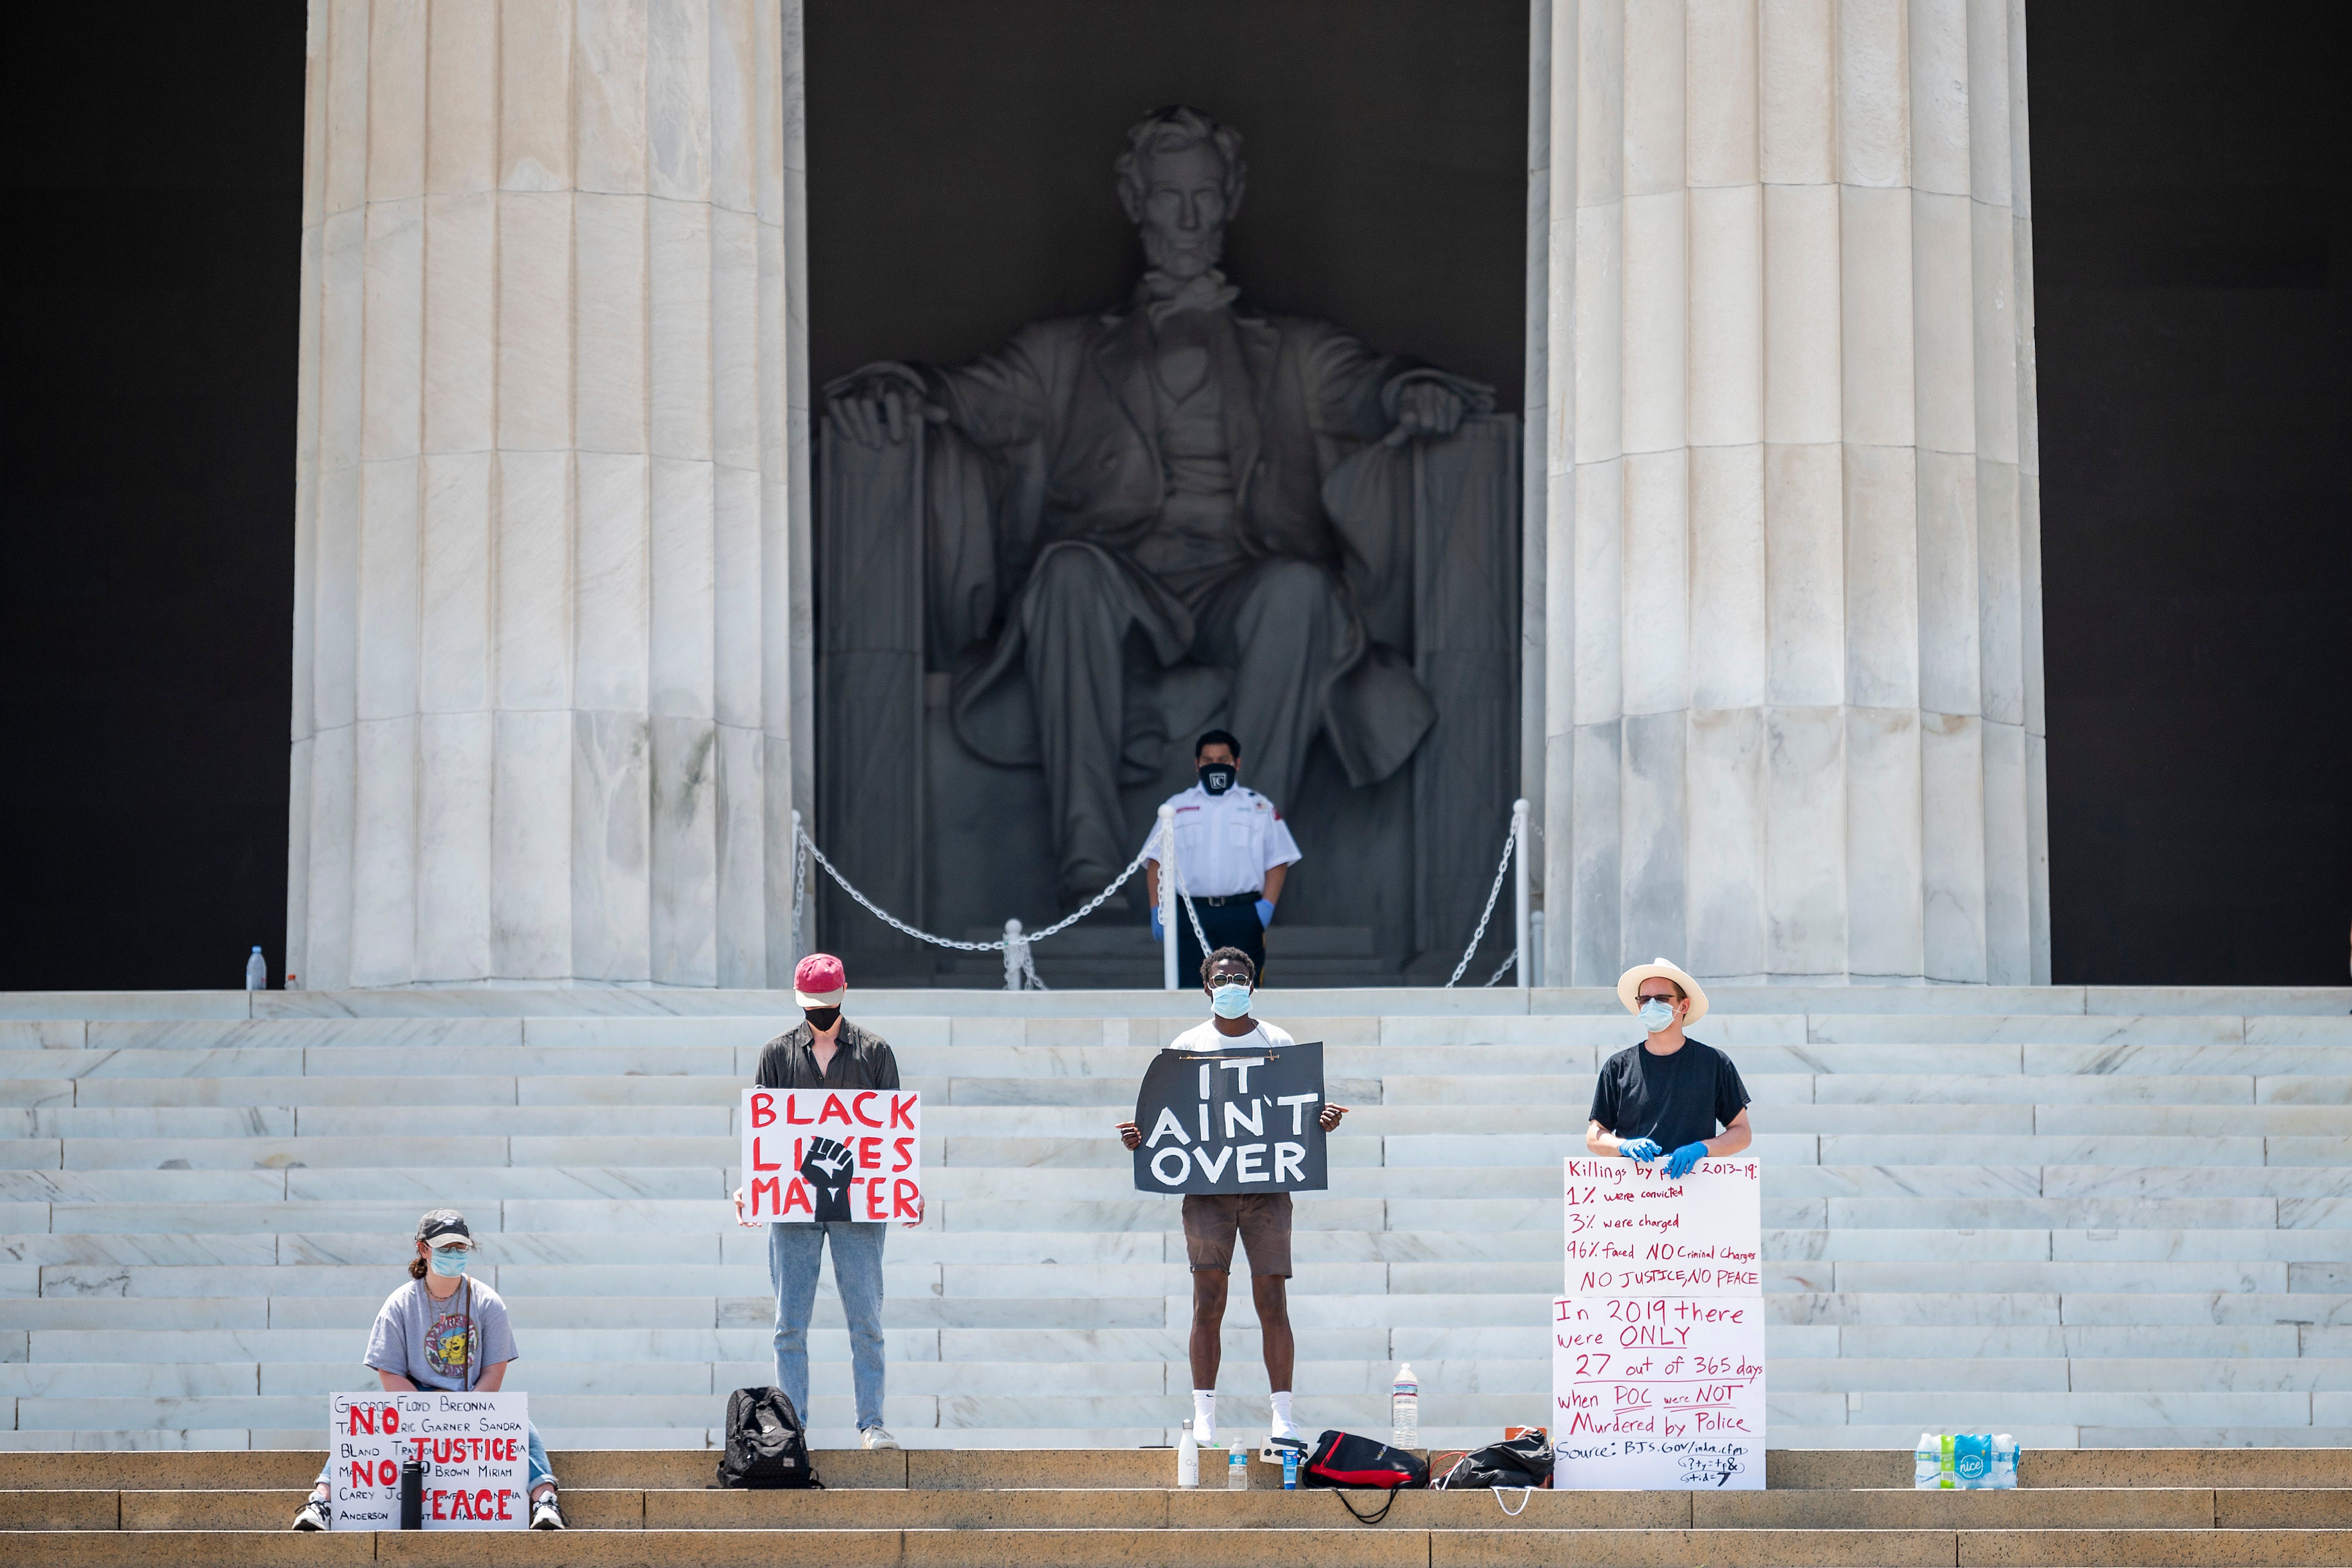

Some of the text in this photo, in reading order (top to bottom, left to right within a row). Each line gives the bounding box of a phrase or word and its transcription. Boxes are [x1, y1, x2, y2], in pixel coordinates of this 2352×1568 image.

[1199, 1058, 1264, 1100] IT
[751, 1092, 917, 1131] BLACK
[1146, 1093, 1318, 1149] AIN'T
[753, 1136, 915, 1173] LIES
[1150, 1142, 1306, 1186] OVER
[1569, 1161, 1627, 1185] Killings
[1635, 1161, 1652, 1180] by
[751, 1176, 919, 1220] MAER
[1567, 1185, 1683, 1206] 1% were convicted
[1569, 1213, 1679, 1234] 3% were charged
[1567, 1240, 1756, 1264] 96% faced NO Criminal Charges
[1580, 1271, 1612, 1291] NO
[1717, 1269, 1760, 1288] PEACE
[1554, 1300, 1744, 1326] In 2019 there
[1557, 1325, 1690, 1348] were ONLY
[1576, 1354, 1763, 1384] 27 out of 365 days
[440, 1395, 495, 1412] BREONNA
[1558, 1384, 1744, 1409] when POC were NOT
[350, 1405, 399, 1436] NO
[421, 1418, 470, 1432] GARNER
[479, 1418, 521, 1432] SANDRA
[1570, 1411, 1751, 1437] Murdered by Police
[341, 1443, 379, 1458] BLAND
[390, 1440, 435, 1456] TRAYON
[409, 1437, 517, 1464] JUSTICE
[1556, 1442, 1617, 1461] Source:
[351, 1459, 397, 1489] NO
[435, 1465, 512, 1478] BROWN MIRIAM
[339, 1487, 375, 1501] CAREY
[422, 1489, 512, 1521] EACE
[339, 1510, 388, 1520] ANDERSON
